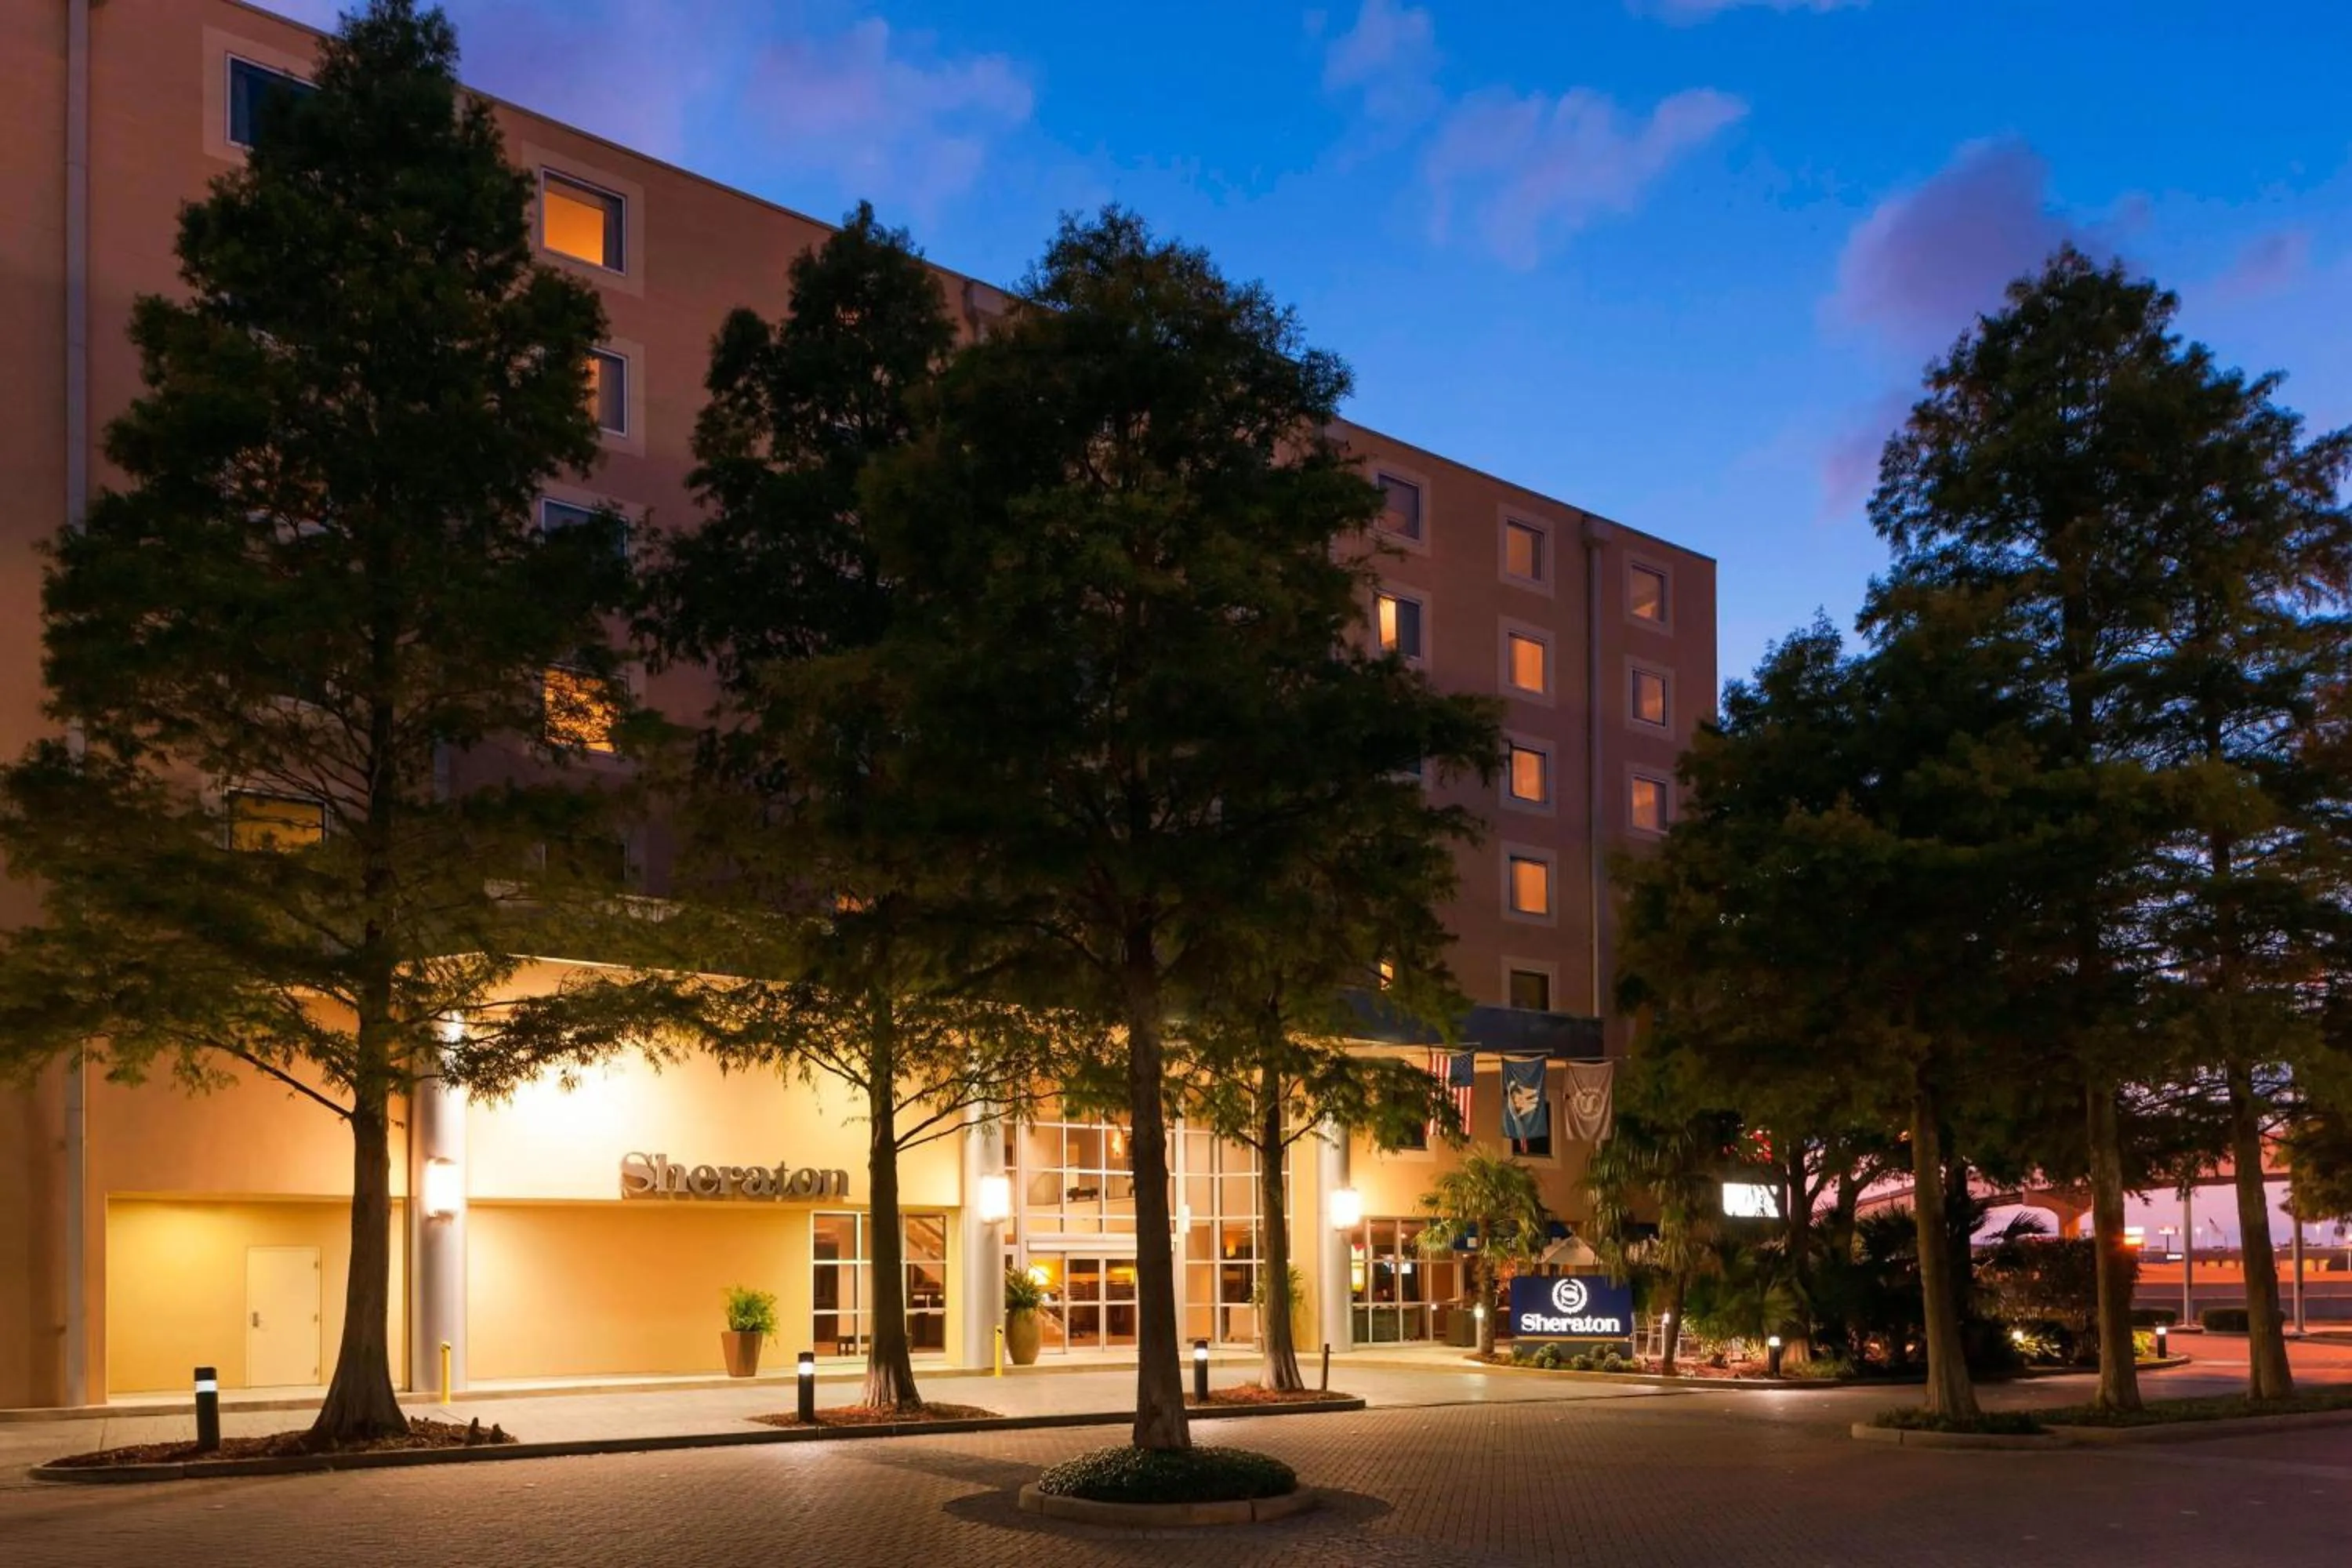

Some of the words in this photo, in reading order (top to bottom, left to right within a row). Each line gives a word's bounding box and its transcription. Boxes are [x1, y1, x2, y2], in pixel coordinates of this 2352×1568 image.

[620, 1152, 851, 1197] Sheraton
[1560, 1284, 1580, 1305] S
[1520, 1312, 1621, 1333] Sheraton
